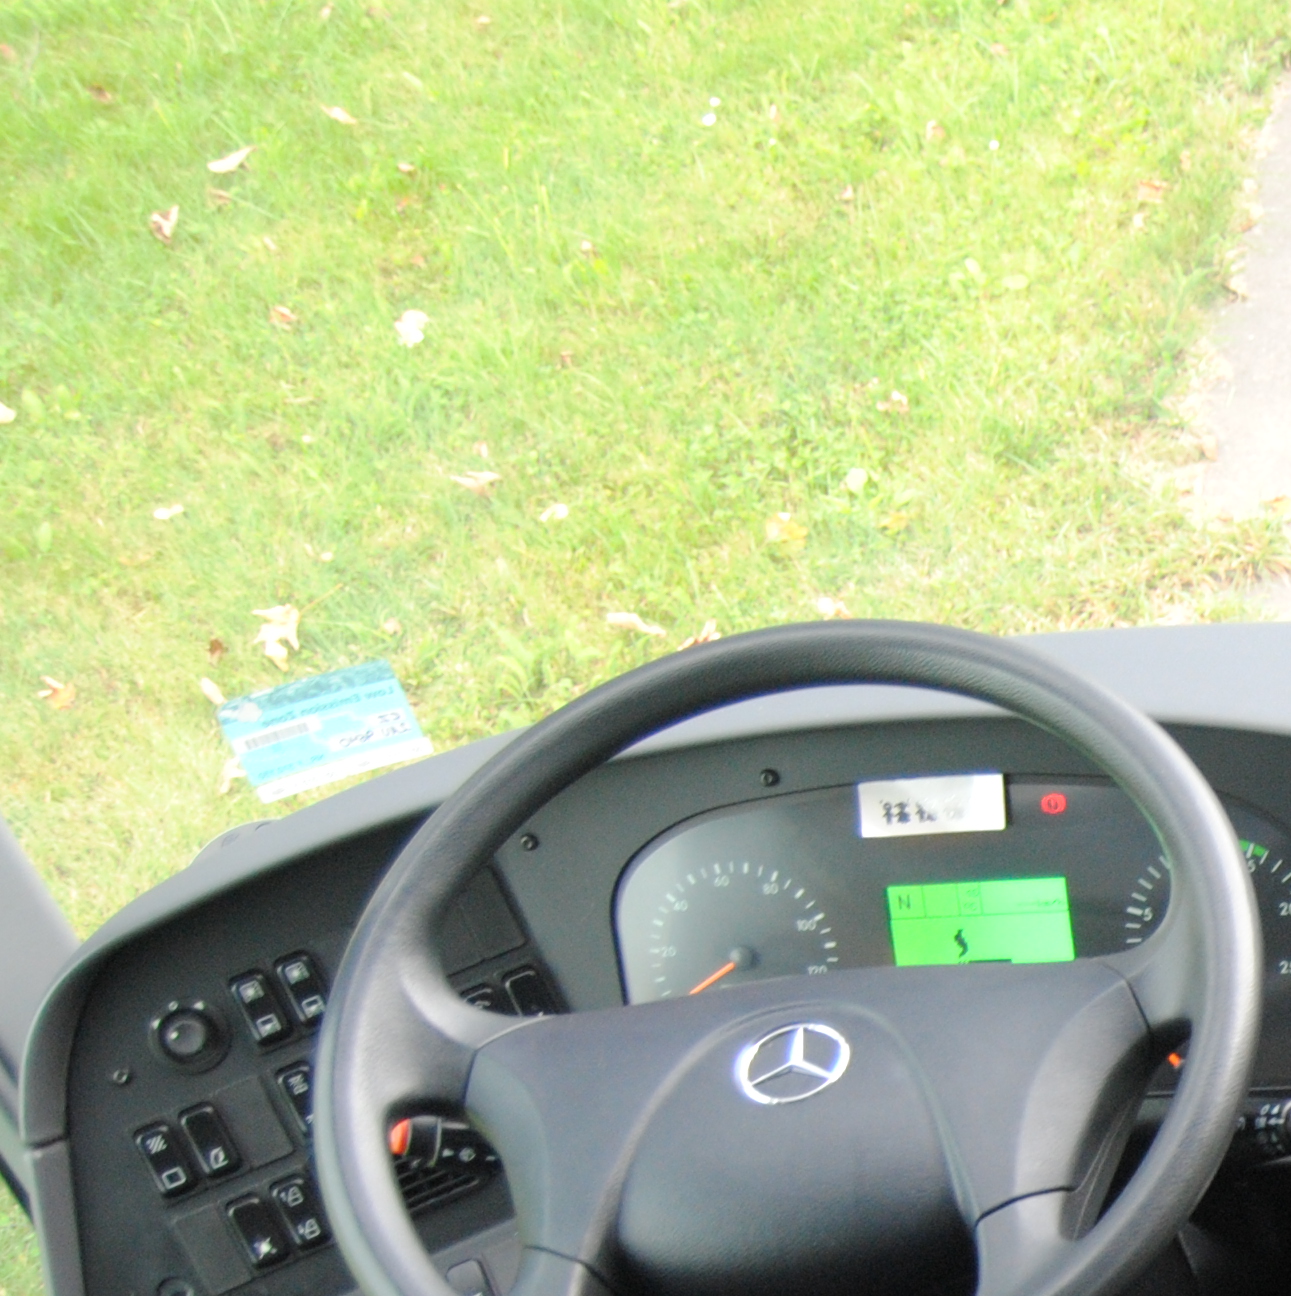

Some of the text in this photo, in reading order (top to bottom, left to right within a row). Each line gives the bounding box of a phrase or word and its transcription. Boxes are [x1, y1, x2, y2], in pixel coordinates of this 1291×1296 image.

[713, 875, 730, 887] 60
[763, 882, 779, 895] 80
[673, 900, 689, 912] 40
[898, 894, 911, 910] N
[1142, 907, 1153, 921] 5
[797, 918, 817, 931] 100
[661, 946, 677, 957] 20
